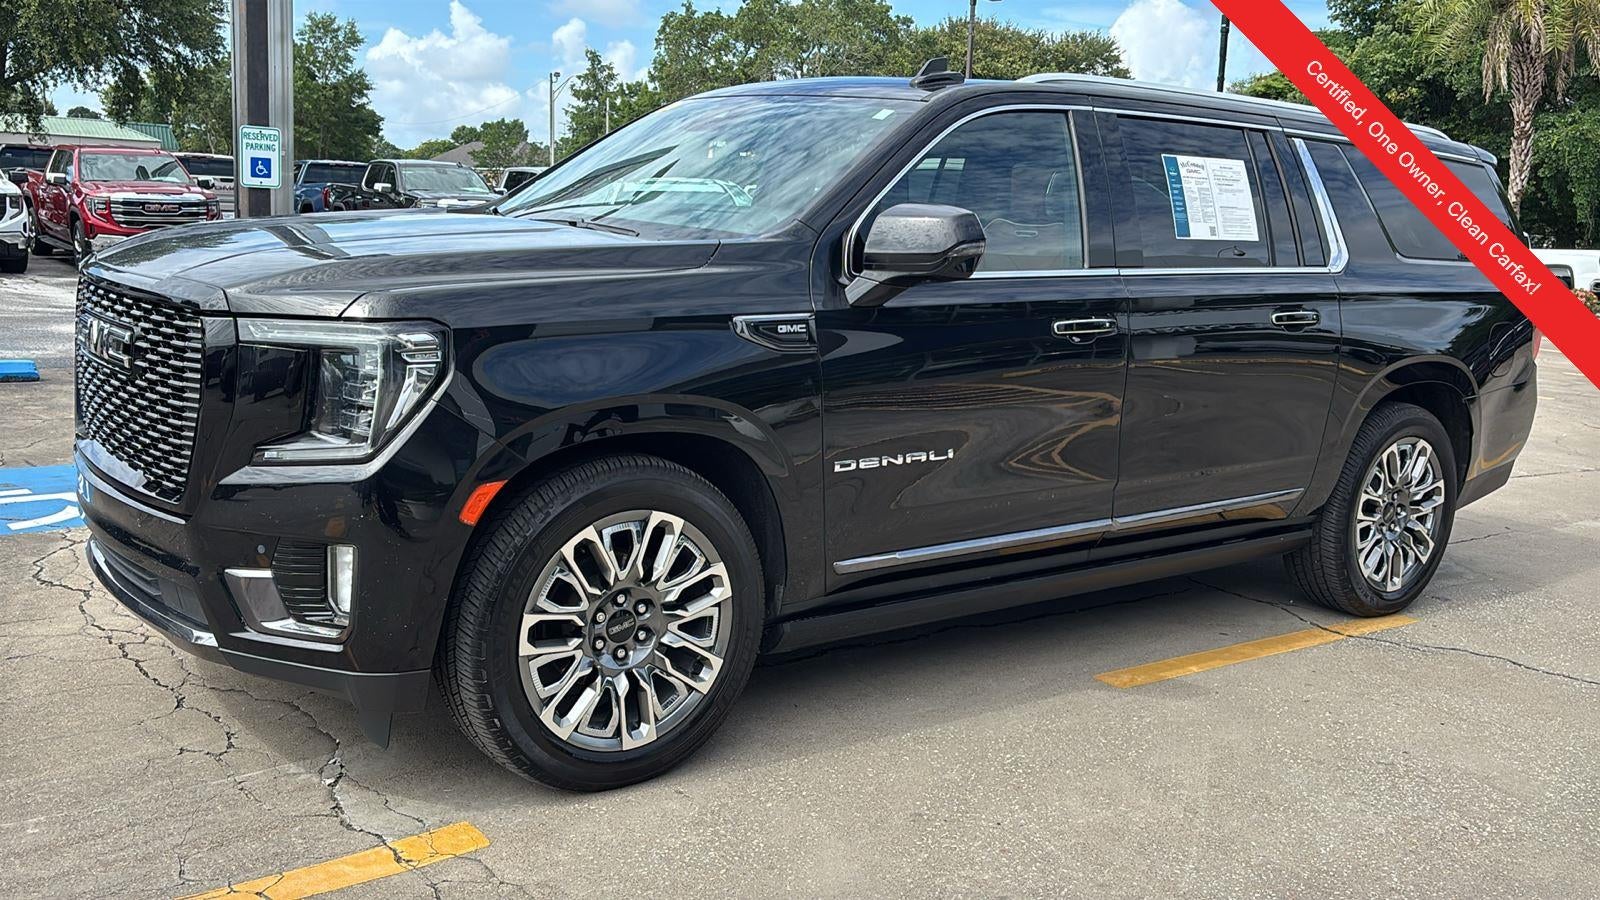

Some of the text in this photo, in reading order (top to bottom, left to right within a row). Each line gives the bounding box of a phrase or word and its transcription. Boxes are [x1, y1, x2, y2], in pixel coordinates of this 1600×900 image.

[243, 131, 278, 142] RESERVED
[245, 142, 276, 152] PARKING
[144, 203, 179, 211] GMC
[777, 324, 806, 333] GMC
[833, 448, 954, 473] DENALI
[607, 617, 635, 636] GMC
